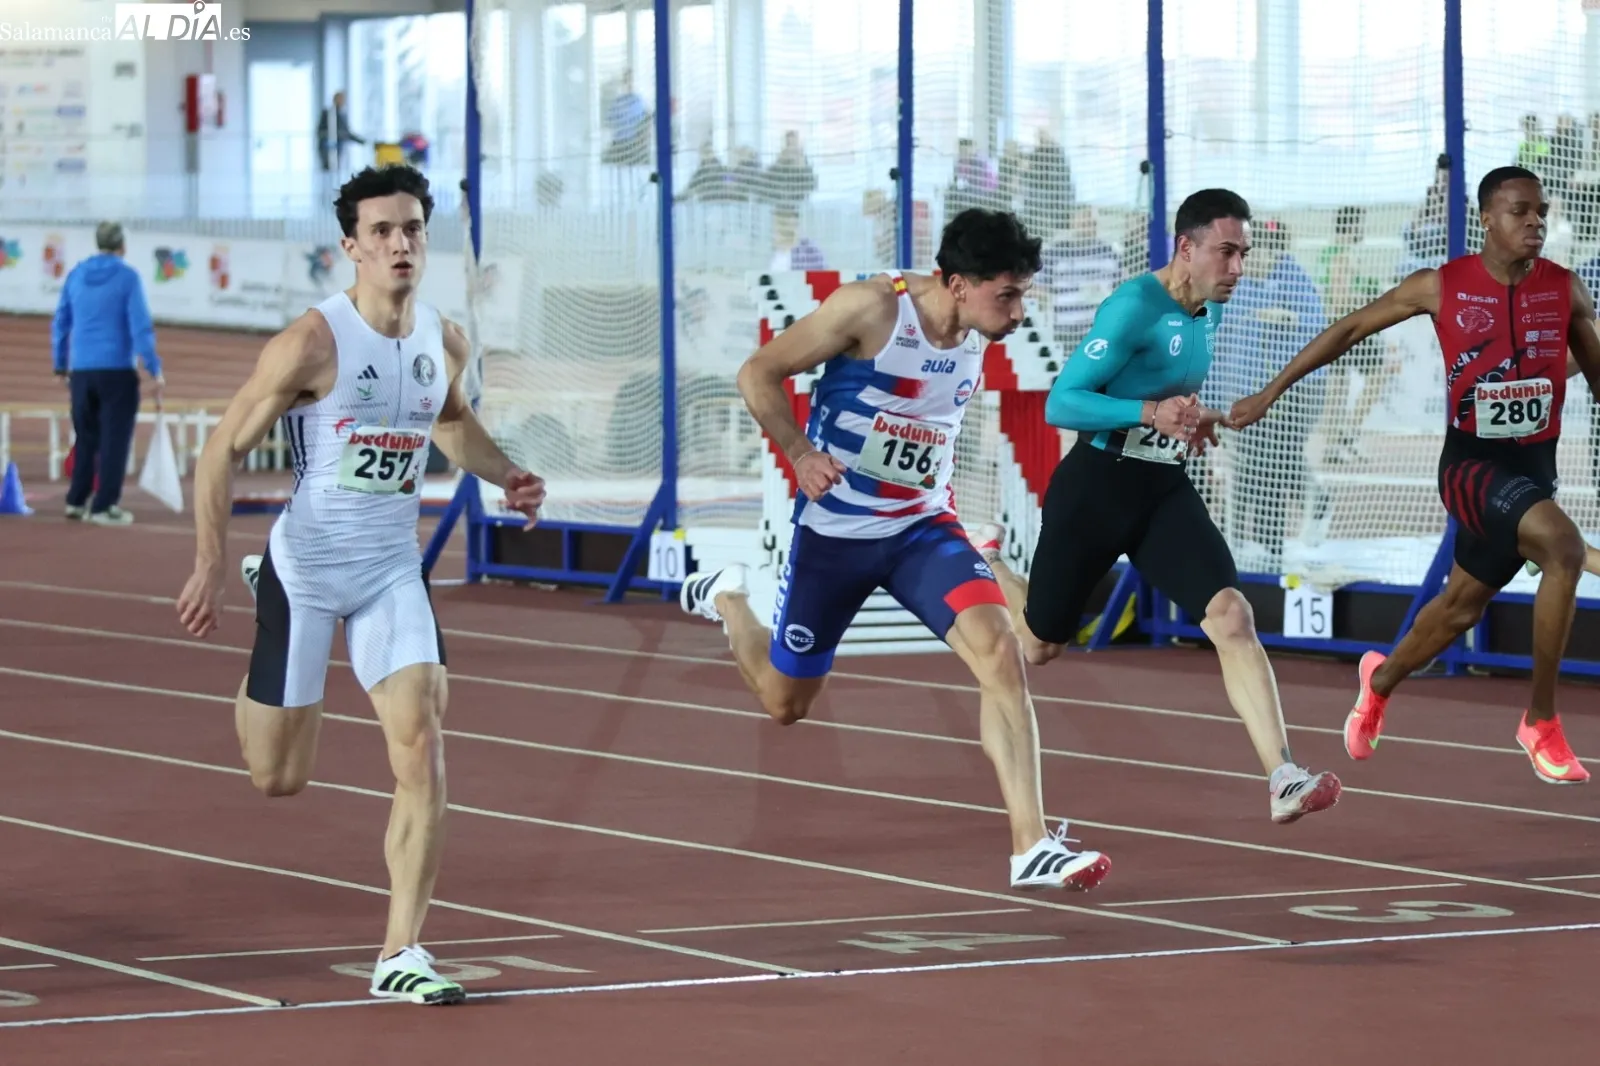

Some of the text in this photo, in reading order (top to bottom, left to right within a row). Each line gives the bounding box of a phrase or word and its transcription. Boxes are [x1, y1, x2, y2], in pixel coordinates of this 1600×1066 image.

[920, 358, 957, 374] aula
[1477, 383, 1552, 400] bedunia
[1489, 398, 1542, 426] 280
[348, 433, 426, 450] bedunia
[873, 416, 947, 445] bedunia
[354, 448, 415, 481] 257
[882, 438, 934, 475] 156
[655, 546, 678, 578] 10
[1293, 596, 1326, 635] 15
